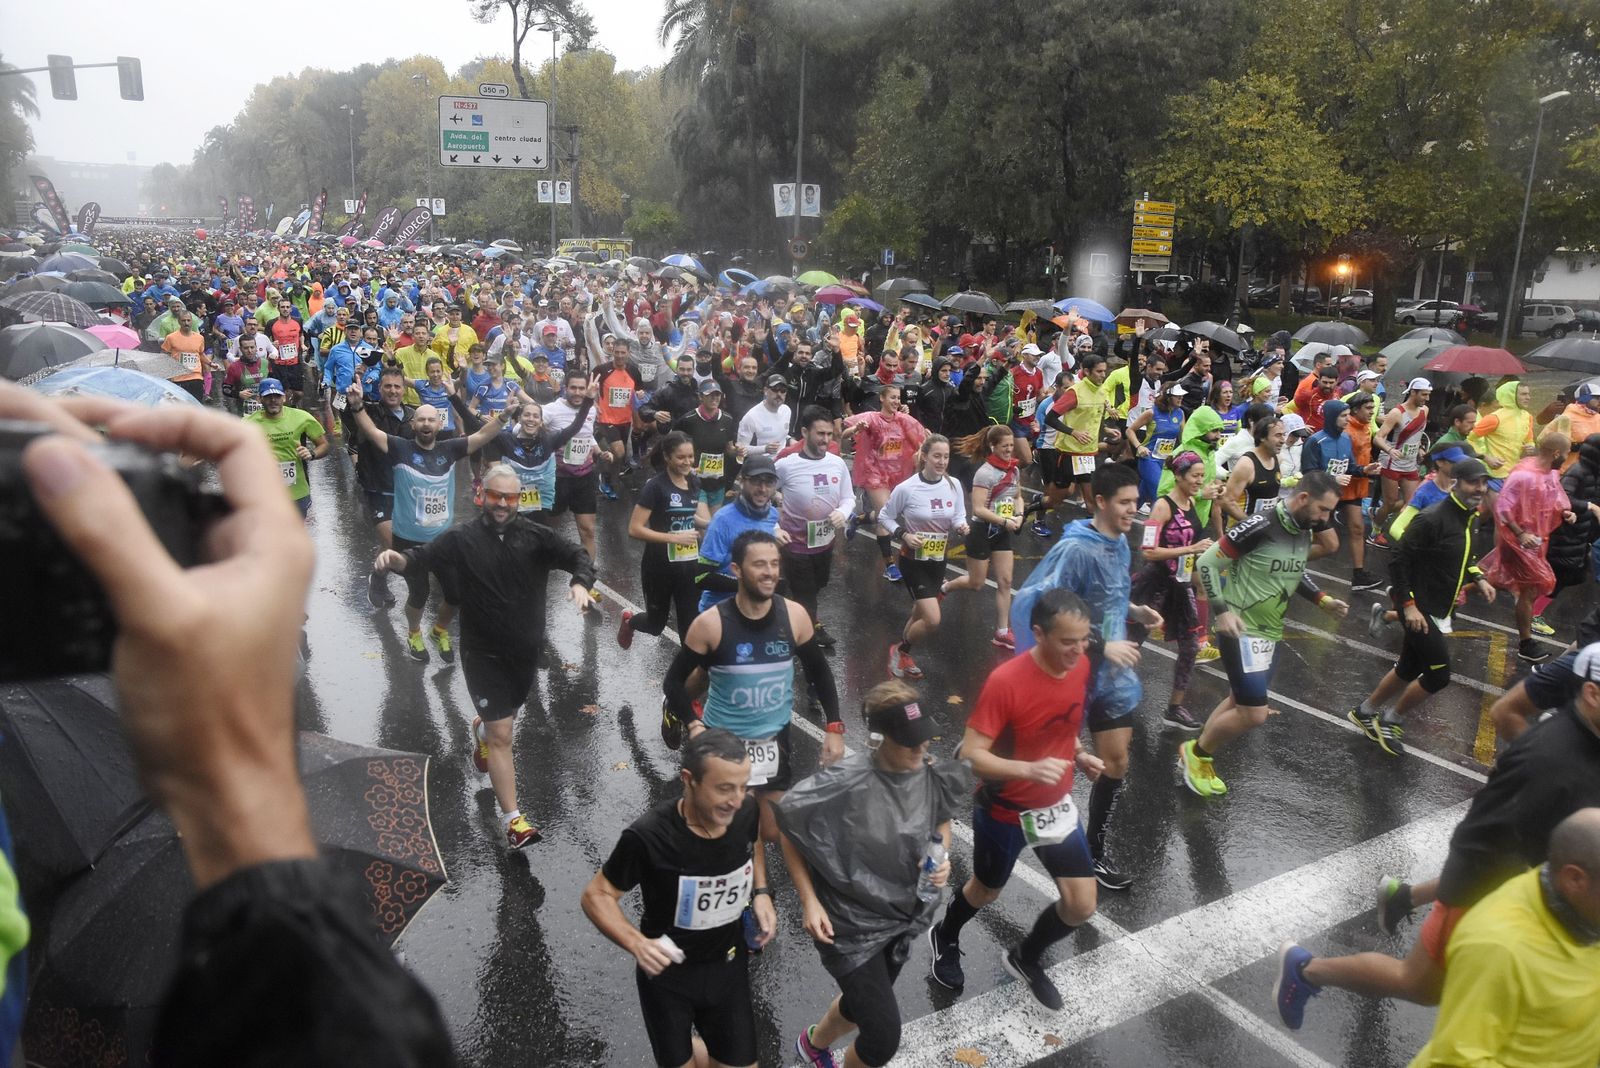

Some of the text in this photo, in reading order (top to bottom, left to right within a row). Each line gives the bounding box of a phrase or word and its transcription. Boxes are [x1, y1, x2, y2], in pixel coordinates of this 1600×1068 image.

[454, 102, 477, 110] N-437
[447, 142, 486, 151] Aeropuerto
[471, 133, 482, 141] del
[395, 210, 431, 243] IMDECO
[571, 444, 590, 455] 4007
[521, 491, 540, 503] 911
[1228, 514, 1264, 542] pulso
[1200, 565, 1218, 599] pulso
[731, 676, 786, 708] aira
[747, 744, 776, 764] 895
[697, 880, 748, 911] 6751
